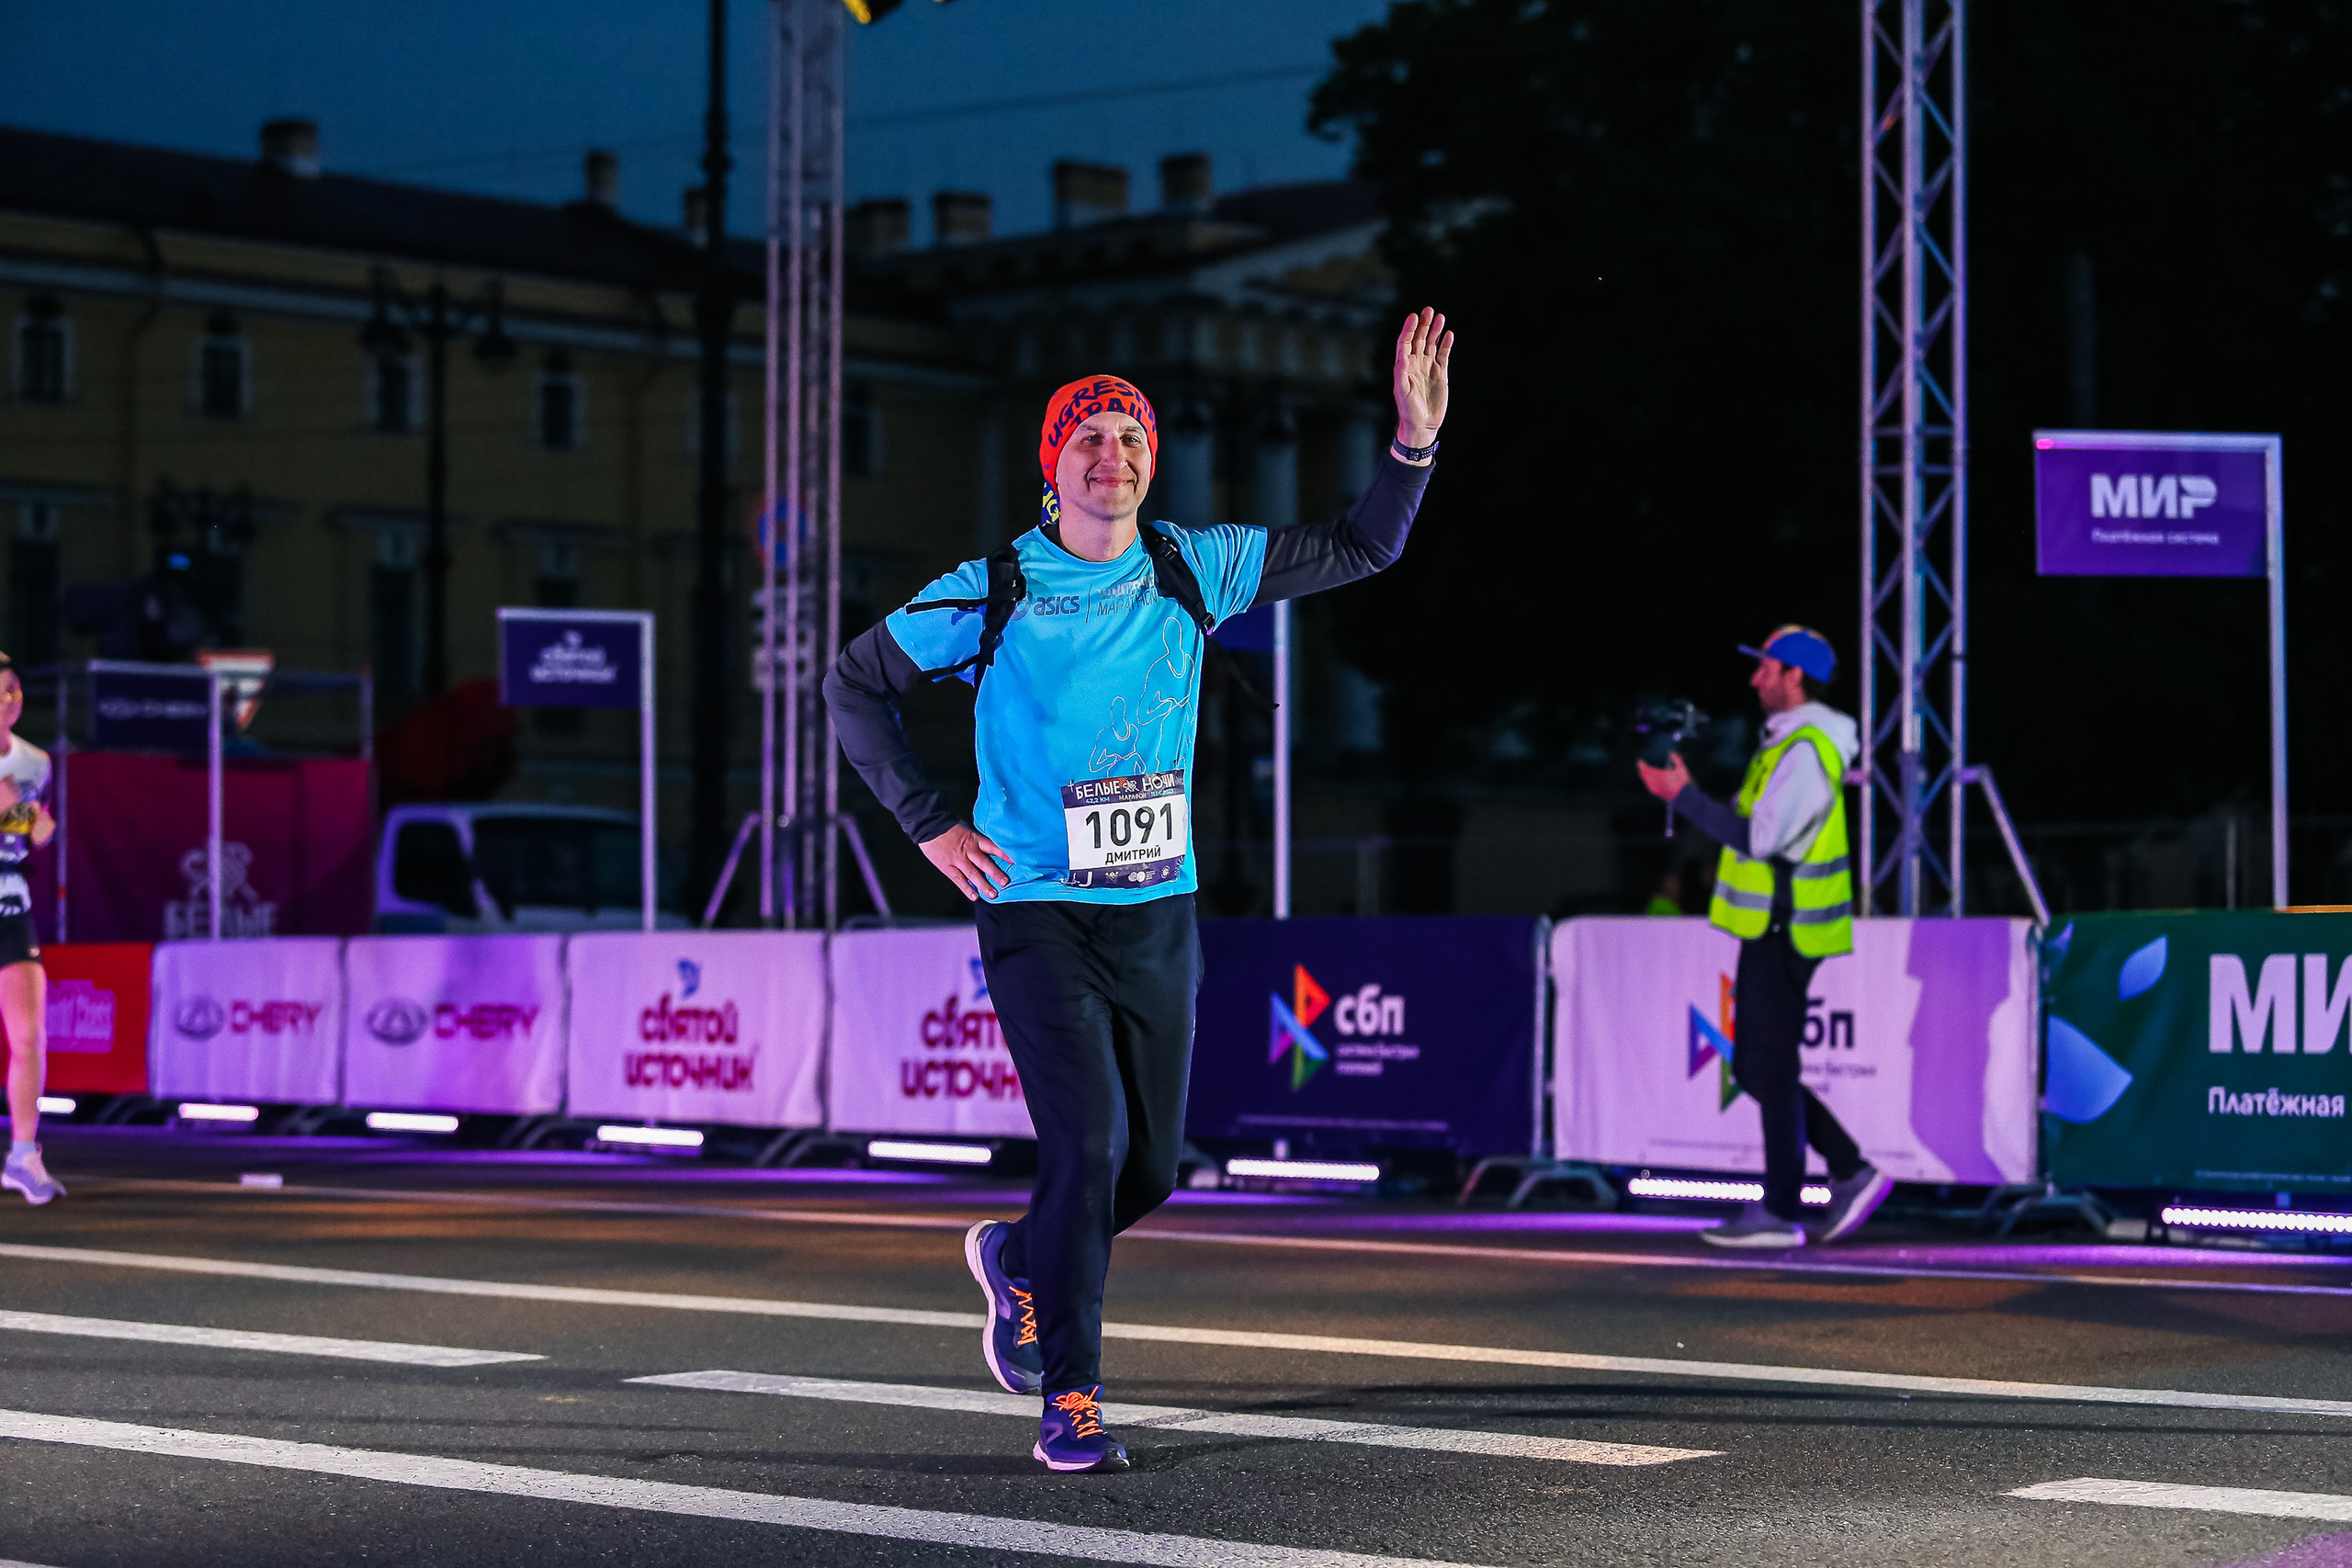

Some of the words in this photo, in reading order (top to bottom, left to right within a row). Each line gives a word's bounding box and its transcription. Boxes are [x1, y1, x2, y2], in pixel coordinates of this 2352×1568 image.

[2090, 472, 2217, 519] МИР
[1034, 596, 1080, 616] asics
[1097, 588, 1159, 616] MARATHON
[1075, 780, 1121, 800] БЕЛЫЕ
[1142, 773, 1176, 792] НОЧИ
[1085, 803, 1172, 849] 1091
[1105, 845, 1161, 864] ДМИТРИЙ
[232, 1000, 322, 1033] CHERY
[435, 1003, 540, 1038] CHERY
[2209, 953, 2352, 1055] МИ
[1802, 997, 1854, 1049] бп
[2208, 1086, 2345, 1118] Платёжная
